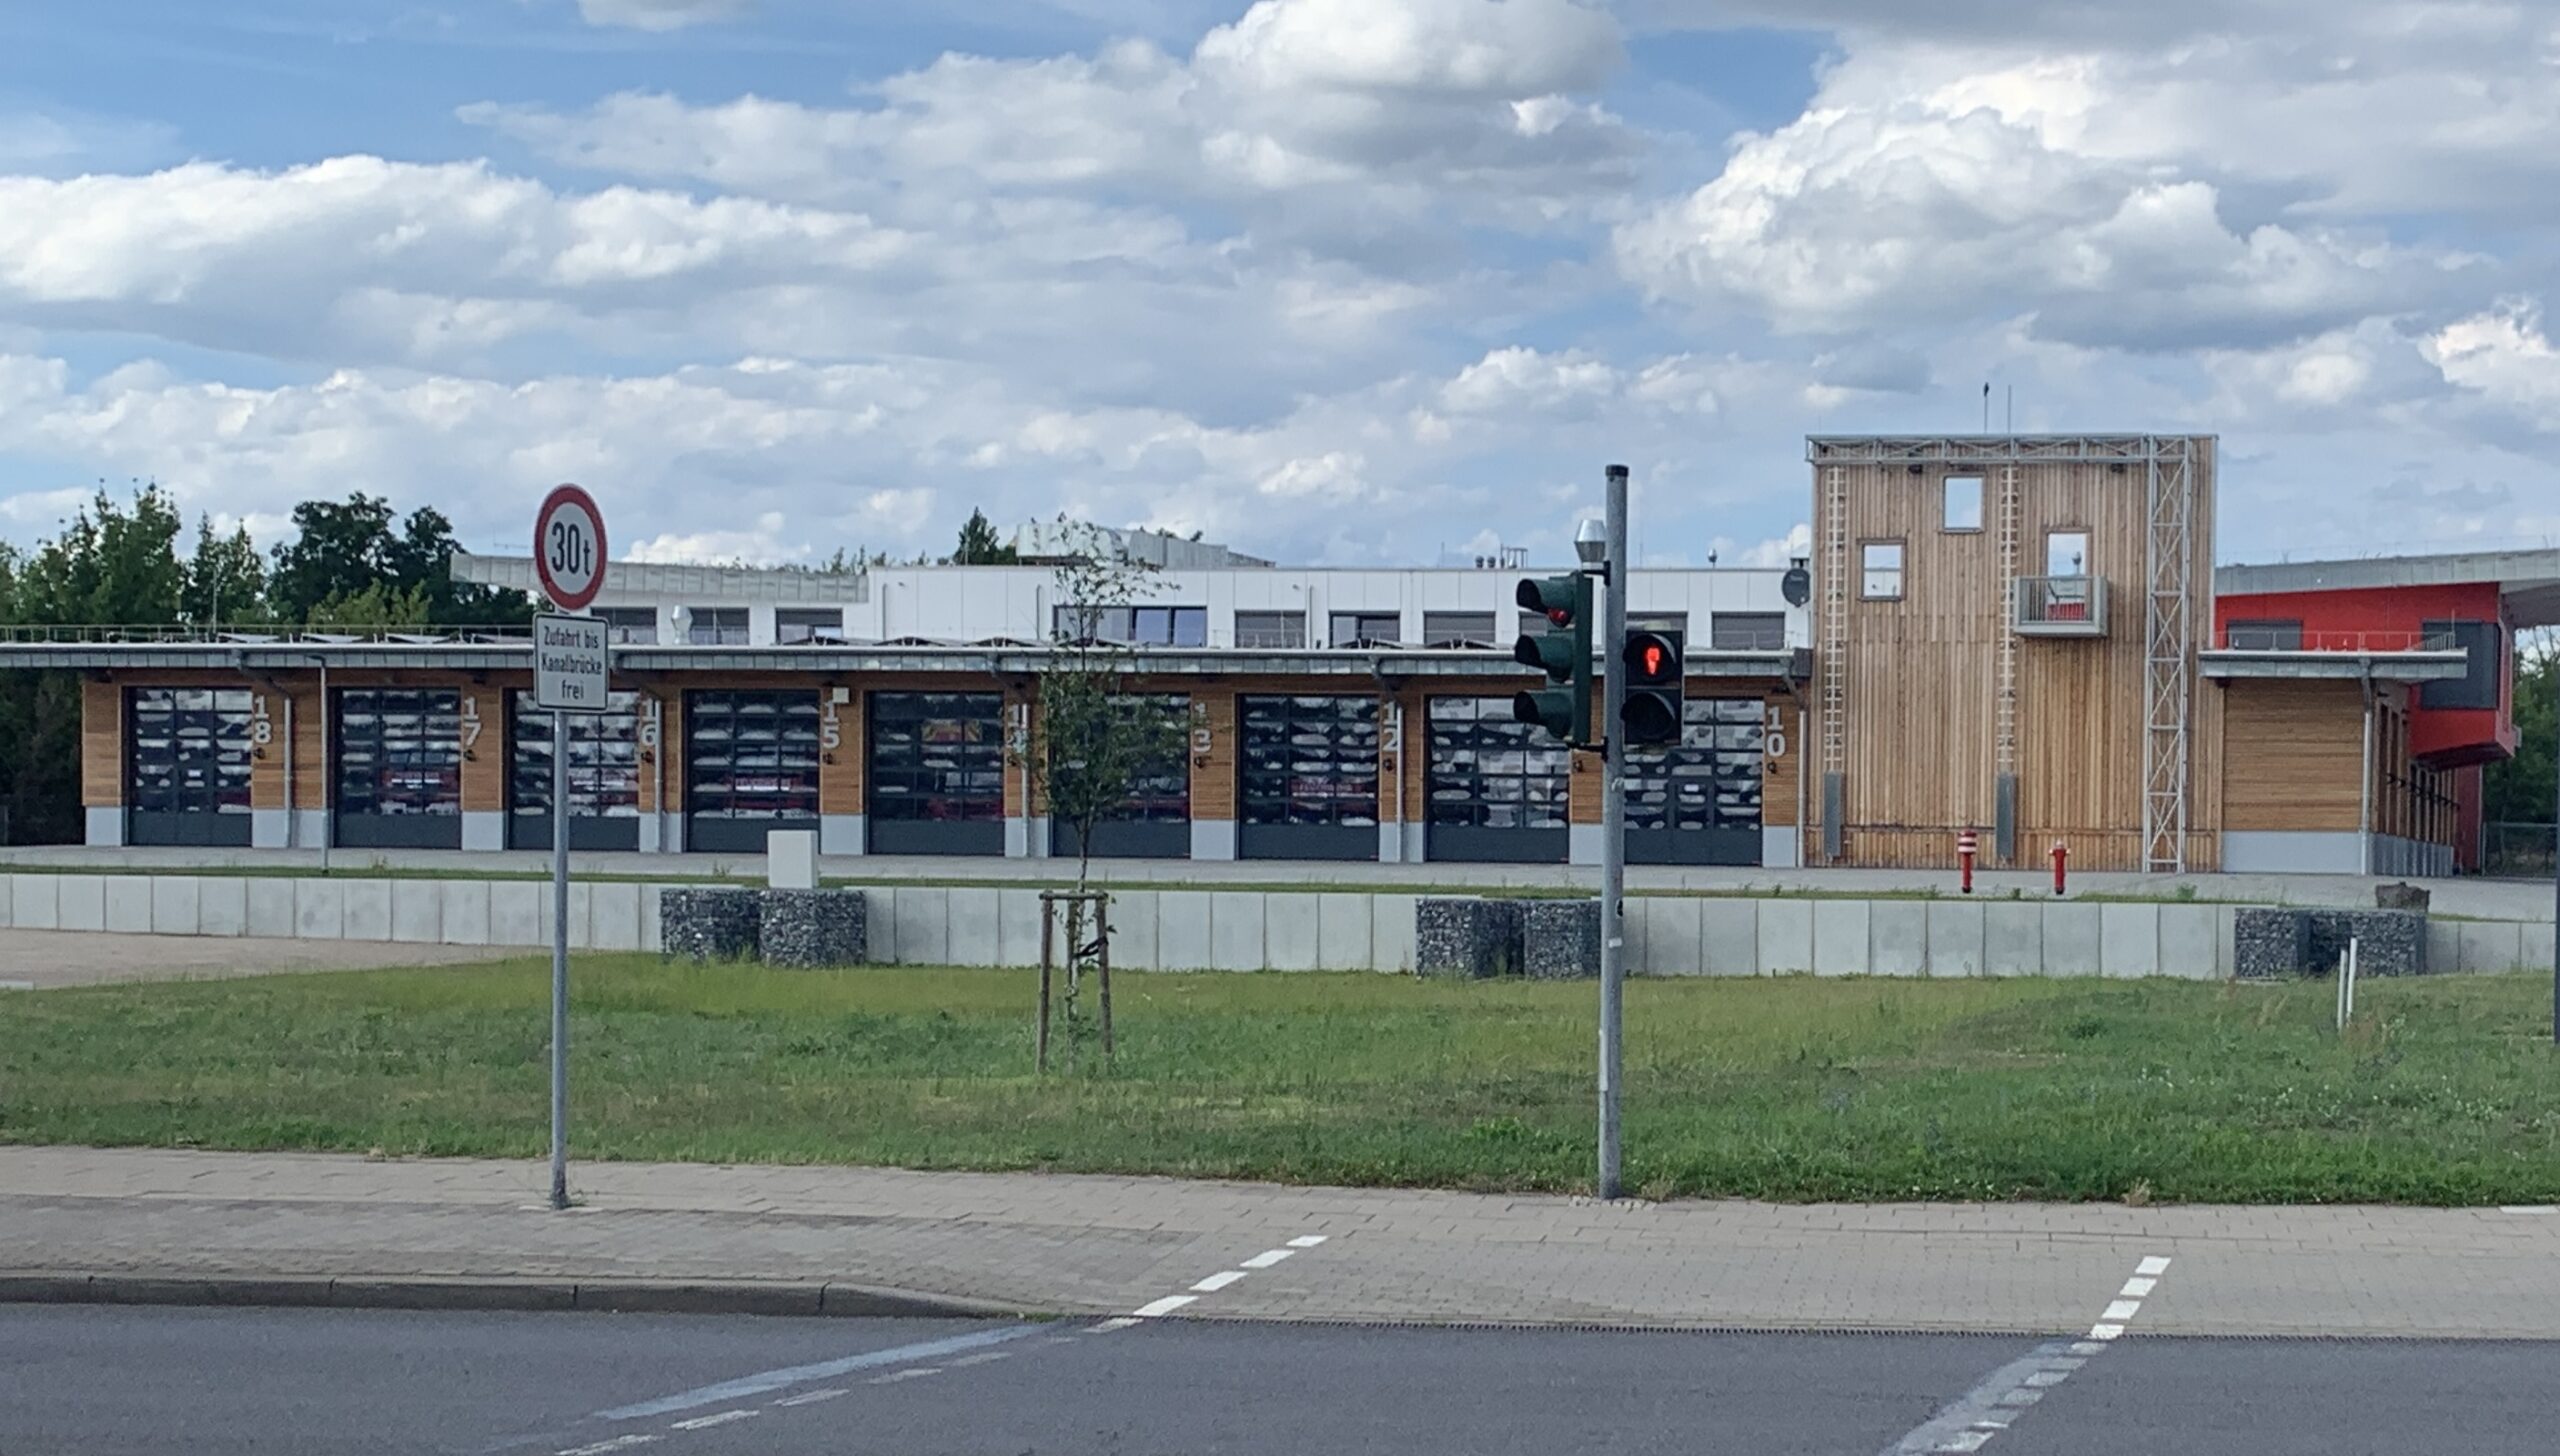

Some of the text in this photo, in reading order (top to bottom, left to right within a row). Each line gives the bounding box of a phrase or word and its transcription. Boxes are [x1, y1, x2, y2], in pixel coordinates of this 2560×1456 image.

[543, 625, 599, 649] Zufahrt bis
[541, 652, 603, 675] Kanalbrücke
[561, 681, 585, 700] frei
[254, 695, 272, 744] 18
[464, 696, 481, 746] 17
[641, 697, 657, 747] 16
[823, 699, 841, 749] 15
[1382, 702, 1399, 752] 12
[1766, 706, 1786, 757] 10
